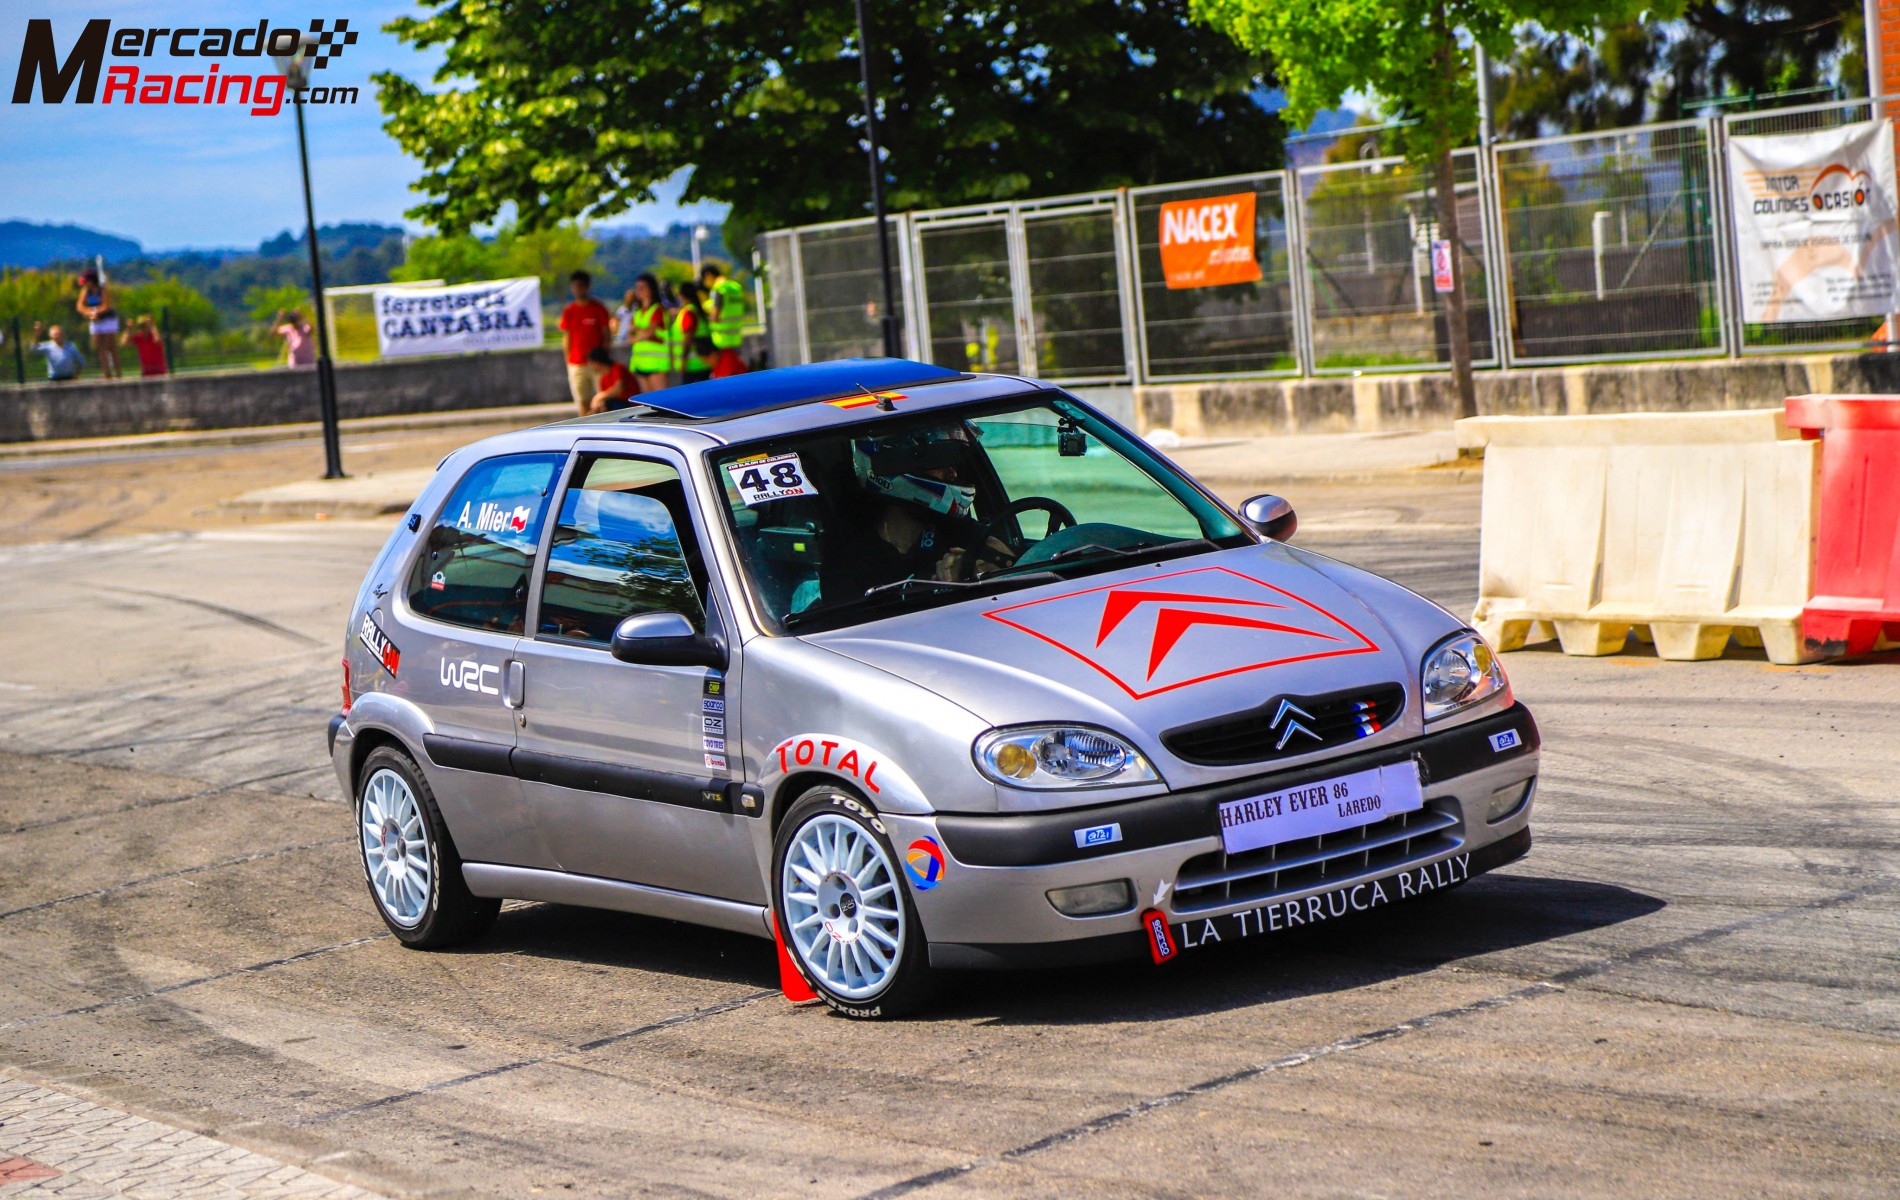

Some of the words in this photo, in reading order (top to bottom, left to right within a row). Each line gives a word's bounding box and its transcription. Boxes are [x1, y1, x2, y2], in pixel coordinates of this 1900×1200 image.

[1163, 202, 1238, 246] NACEX
[384, 309, 533, 338] CANTABRA
[740, 463, 803, 492] 48
[753, 488, 804, 501] RALLYON
[456, 500, 472, 529] A.
[476, 502, 511, 532] Mier
[440, 657, 499, 695] WRC
[704, 718, 722, 728] OZ
[776, 740, 880, 793] TOTAL
[703, 791, 721, 801] VTS
[1220, 796, 1282, 828] HARLEY
[1288, 785, 1329, 812] EVER
[1333, 781, 1349, 799] 86
[1338, 795, 1381, 818] LAREDO
[830, 794, 887, 835] TOYO
[1182, 918, 1222, 948] LA
[1233, 881, 1389, 937] TIERRUCA
[1398, 852, 1470, 899] RALLY
[1152, 919, 1170, 956] sparco
